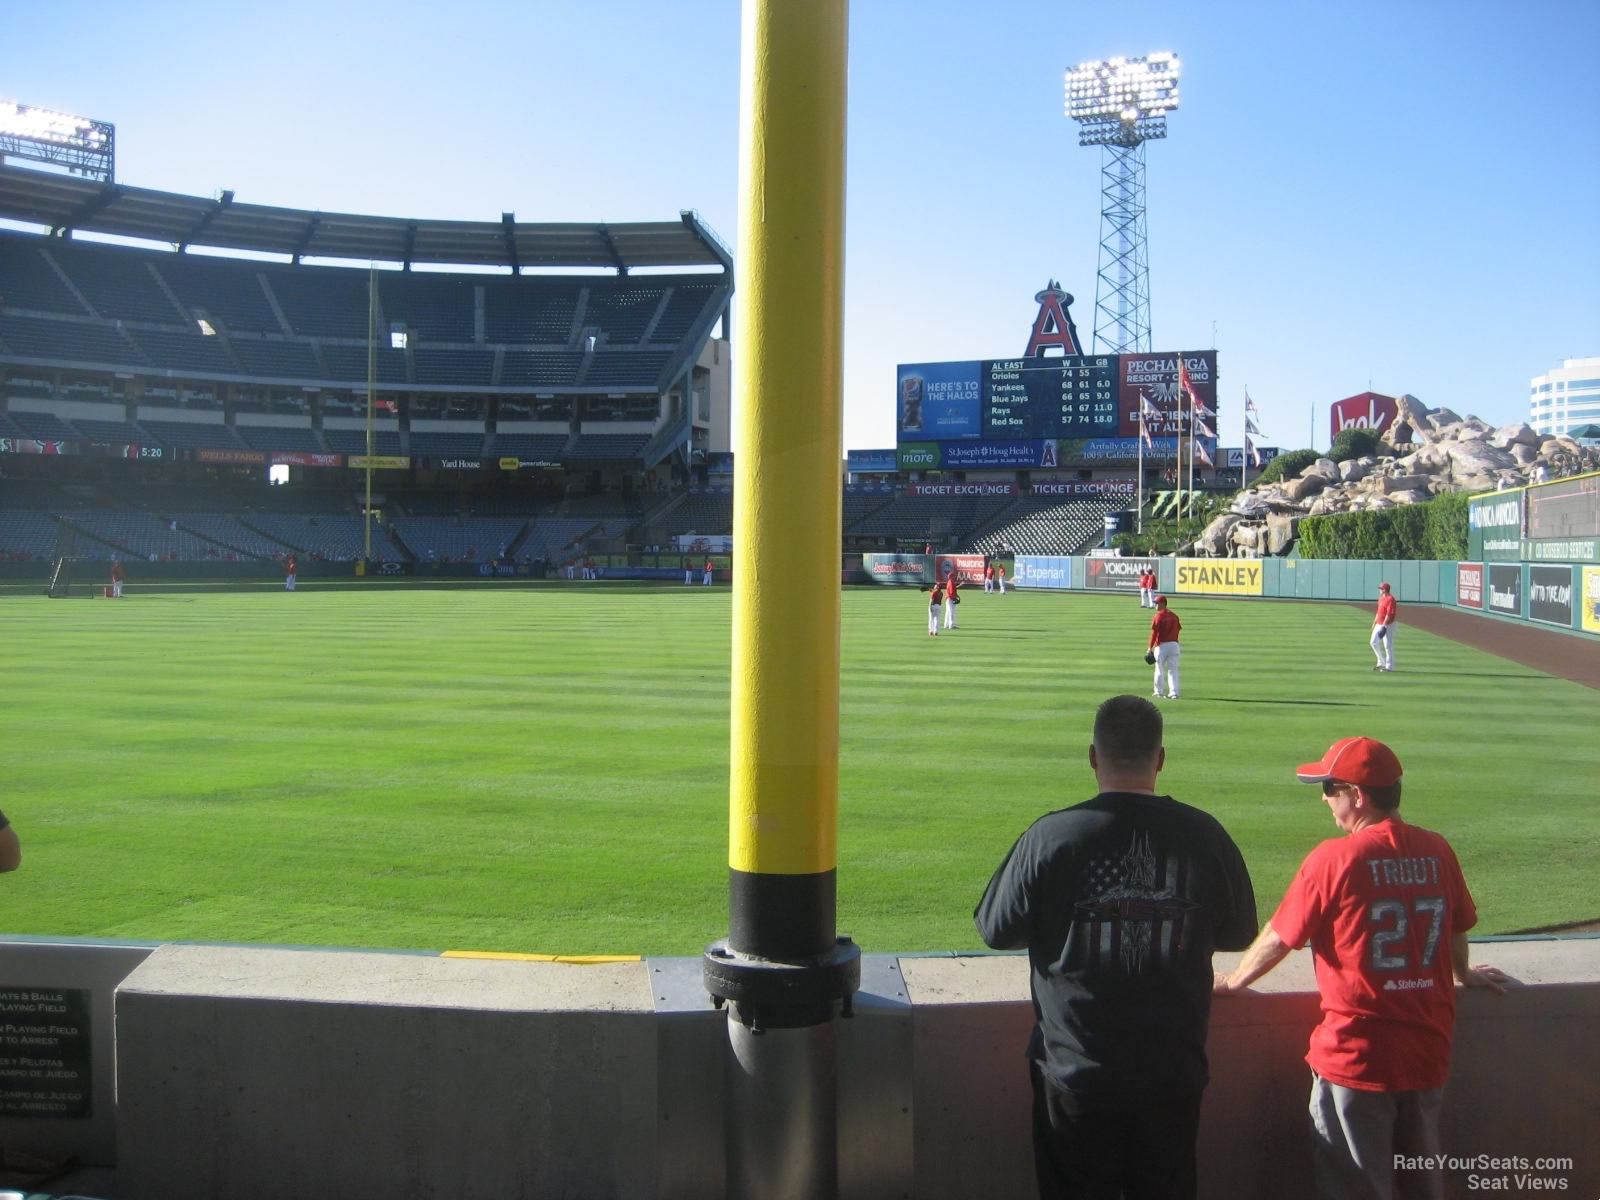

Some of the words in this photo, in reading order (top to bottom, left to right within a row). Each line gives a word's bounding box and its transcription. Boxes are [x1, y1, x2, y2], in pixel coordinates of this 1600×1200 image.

[992, 362, 1002, 370] AL
[1005, 361, 1024, 369] EAST
[992, 372, 1019, 380] Orioles
[1127, 374, 1163, 382] RESORT
[927, 382, 962, 392] HERE'S
[964, 381, 978, 390] TO
[992, 384, 1024, 392] Yankees
[1062, 381, 1072, 389] 68
[928, 392, 945, 401] THE
[947, 391, 979, 400] HALOS
[992, 395, 1008, 403] Blue
[1011, 395, 1028, 403] Jays
[1097, 392, 1110, 400] 9.0
[992, 407, 1010, 415] Rays
[1094, 415, 1112, 423] 18.0
[1149, 423, 1160, 432] IT
[1163, 423, 1186, 432] ALL
[142, 448, 162, 457] 5:20
[903, 454, 933, 463] more
[442, 460, 457, 468] Yard
[458, 460, 480, 468] House
[916, 485, 950, 494] TICKET
[1033, 484, 1070, 494] TICKET
[1026, 567, 1064, 579] Experian
[1178, 567, 1259, 586] STANLEY
[1368, 857, 1440, 886] TROUT
[1371, 897, 1444, 969] 27
[31, 992, 63, 1001] BALLS
[38, 1004, 66, 1012] FIELD
[6, 1024, 47, 1034] PLAYING
[50, 1026, 78, 1034] FIELD
[20, 1036, 60, 1045] ARREST
[20, 1058, 64, 1067] PELOTAS
